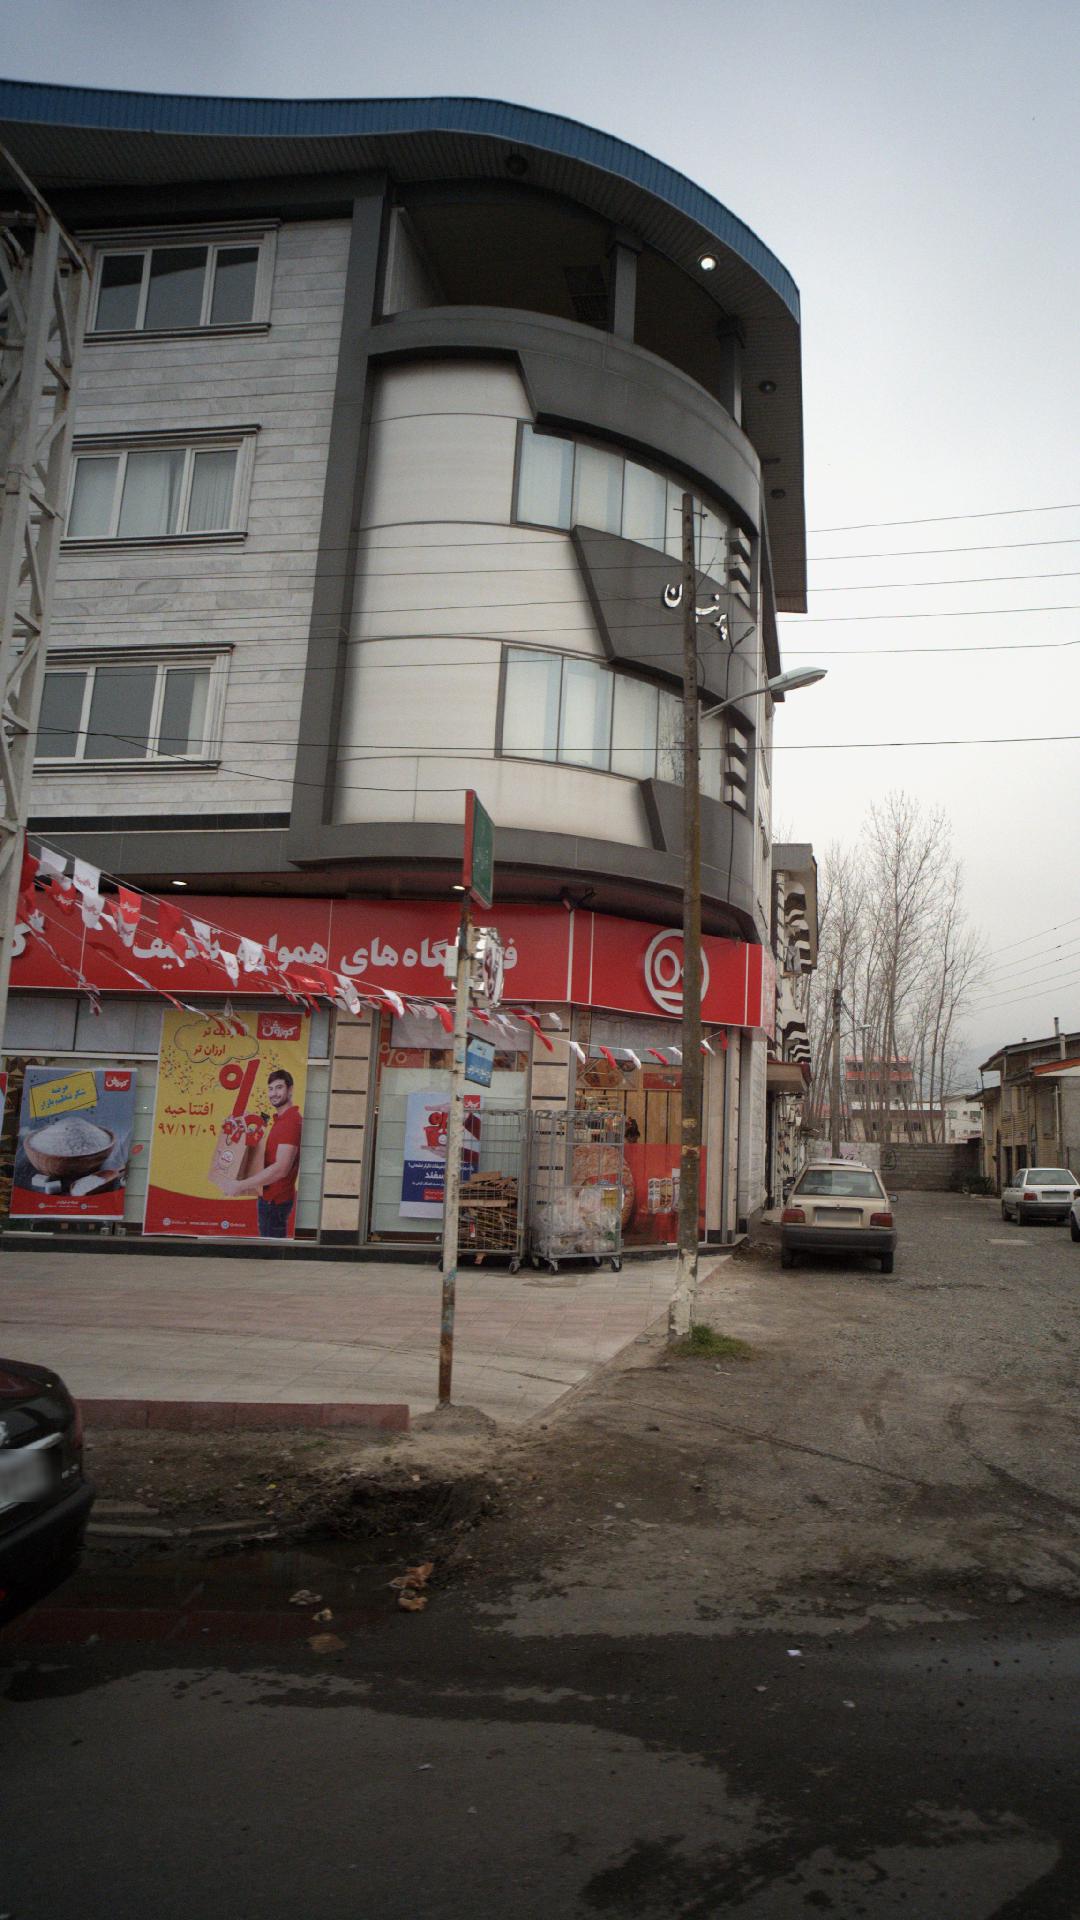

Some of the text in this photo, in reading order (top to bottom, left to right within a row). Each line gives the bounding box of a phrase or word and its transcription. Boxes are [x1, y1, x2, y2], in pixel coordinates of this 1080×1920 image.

[236, 932, 327, 972] هموا
[340, 937, 399, 975] های
[402, 937, 518, 970] فگاه
